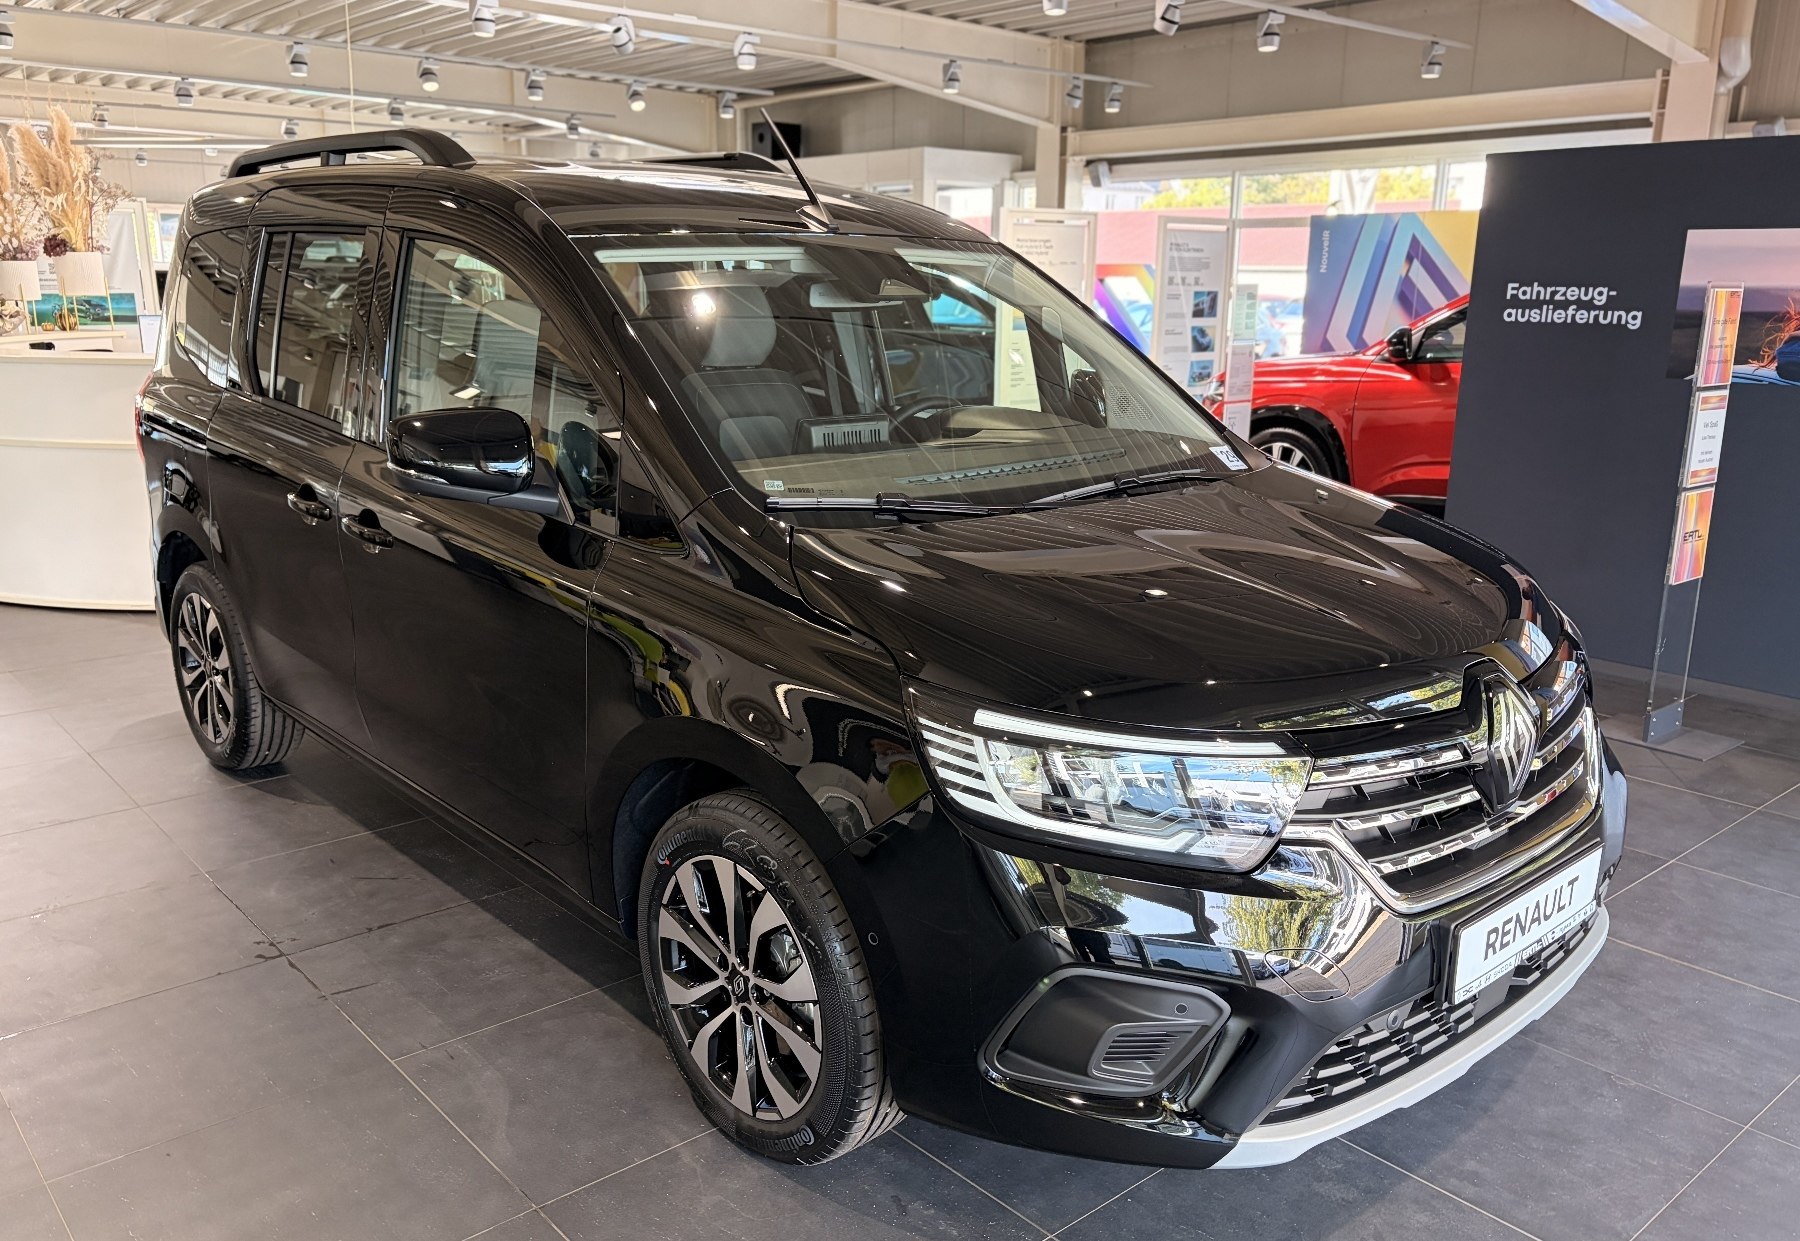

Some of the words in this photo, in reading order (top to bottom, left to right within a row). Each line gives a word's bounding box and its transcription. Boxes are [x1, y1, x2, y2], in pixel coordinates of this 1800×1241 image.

[1505, 281, 1618, 306] Fahrzeug-
[1502, 304, 1643, 330] auslieferung
[1483, 874, 1580, 961] RENAULT
